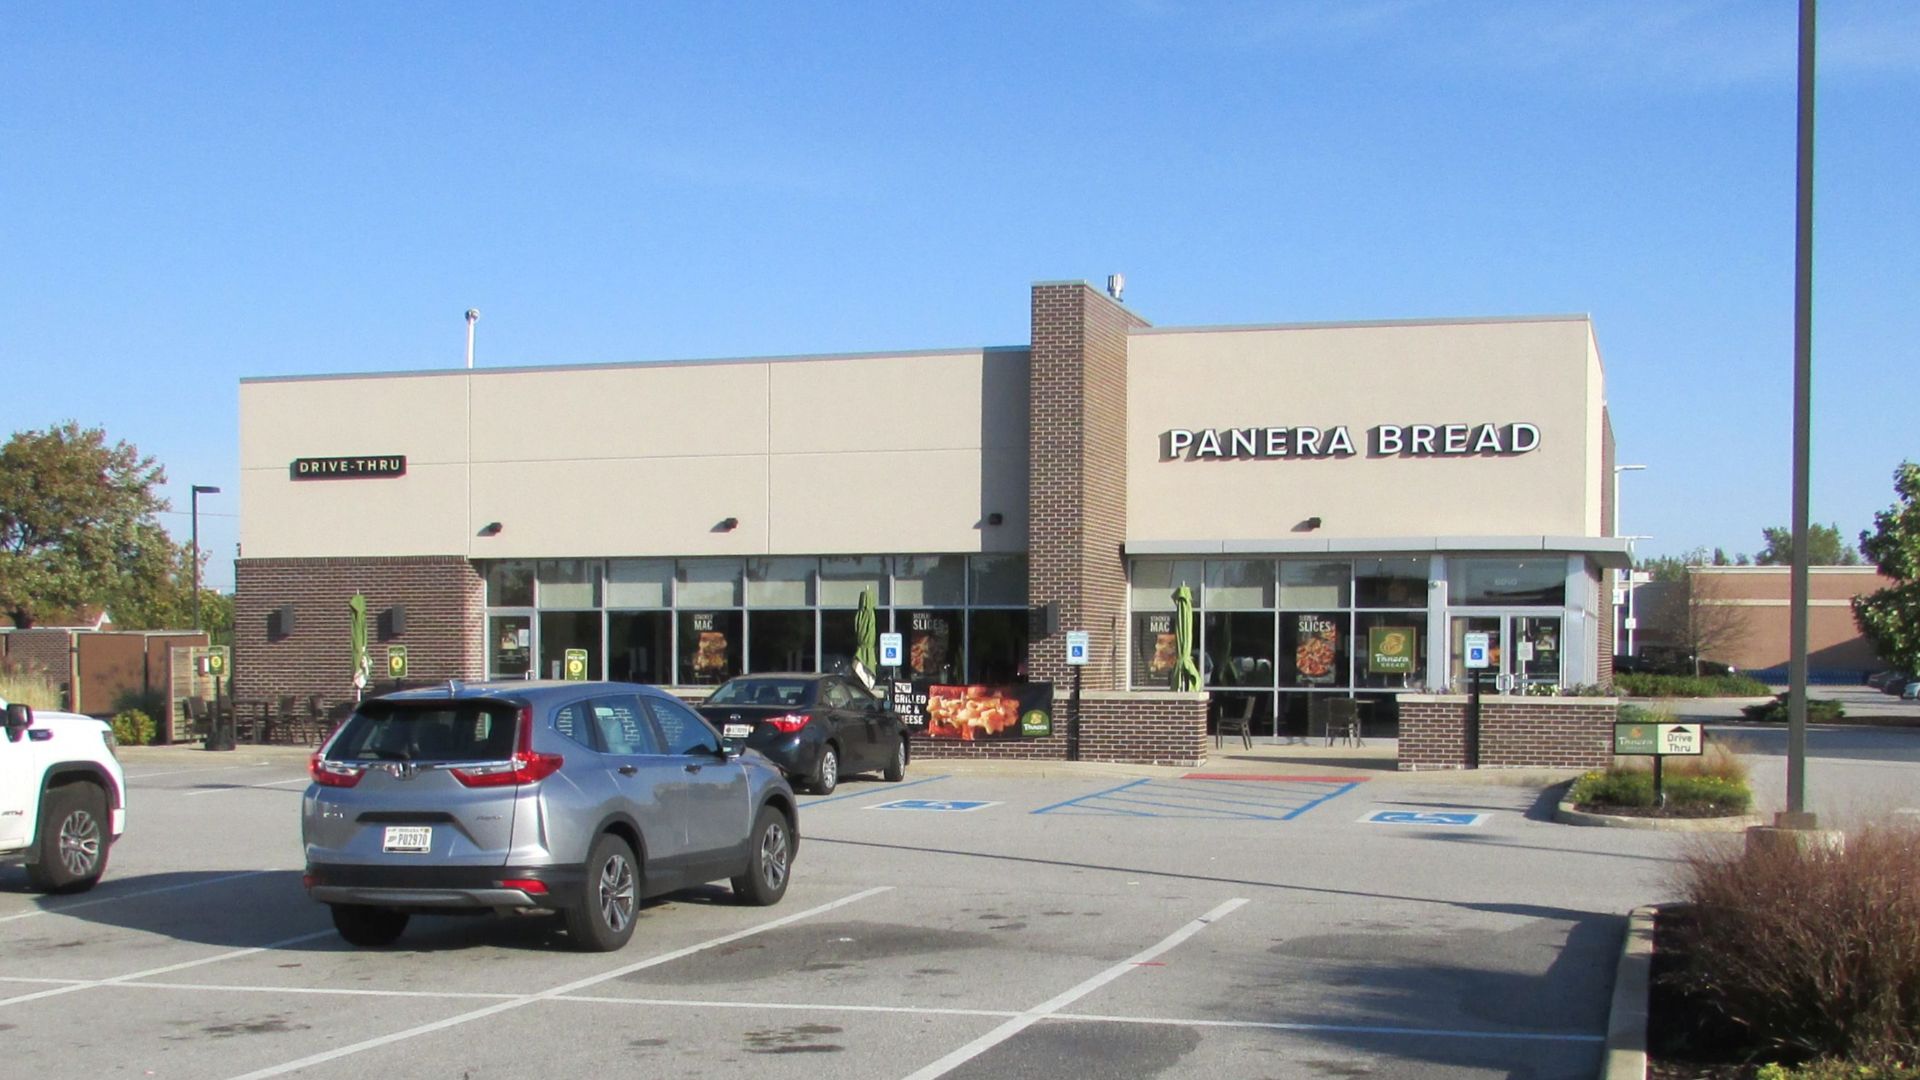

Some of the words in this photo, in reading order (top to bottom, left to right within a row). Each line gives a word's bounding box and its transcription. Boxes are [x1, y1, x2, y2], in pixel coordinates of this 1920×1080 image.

[1166, 426, 1356, 458] PANERA
[1374, 422, 1541, 454] BREAD
[299, 459, 400, 473] DRIVE-THRU
[694, 620, 713, 630] MAC
[913, 619, 944, 630] SLICES
[1150, 621, 1170, 632] MAC
[1298, 621, 1331, 632] SLICES
[894, 694, 927, 704] GRILLED
[894, 704, 911, 714] MAC
[914, 705, 920, 714] &
[1667, 734, 1693, 742] Drive
[1669, 744, 1691, 752] Thru
